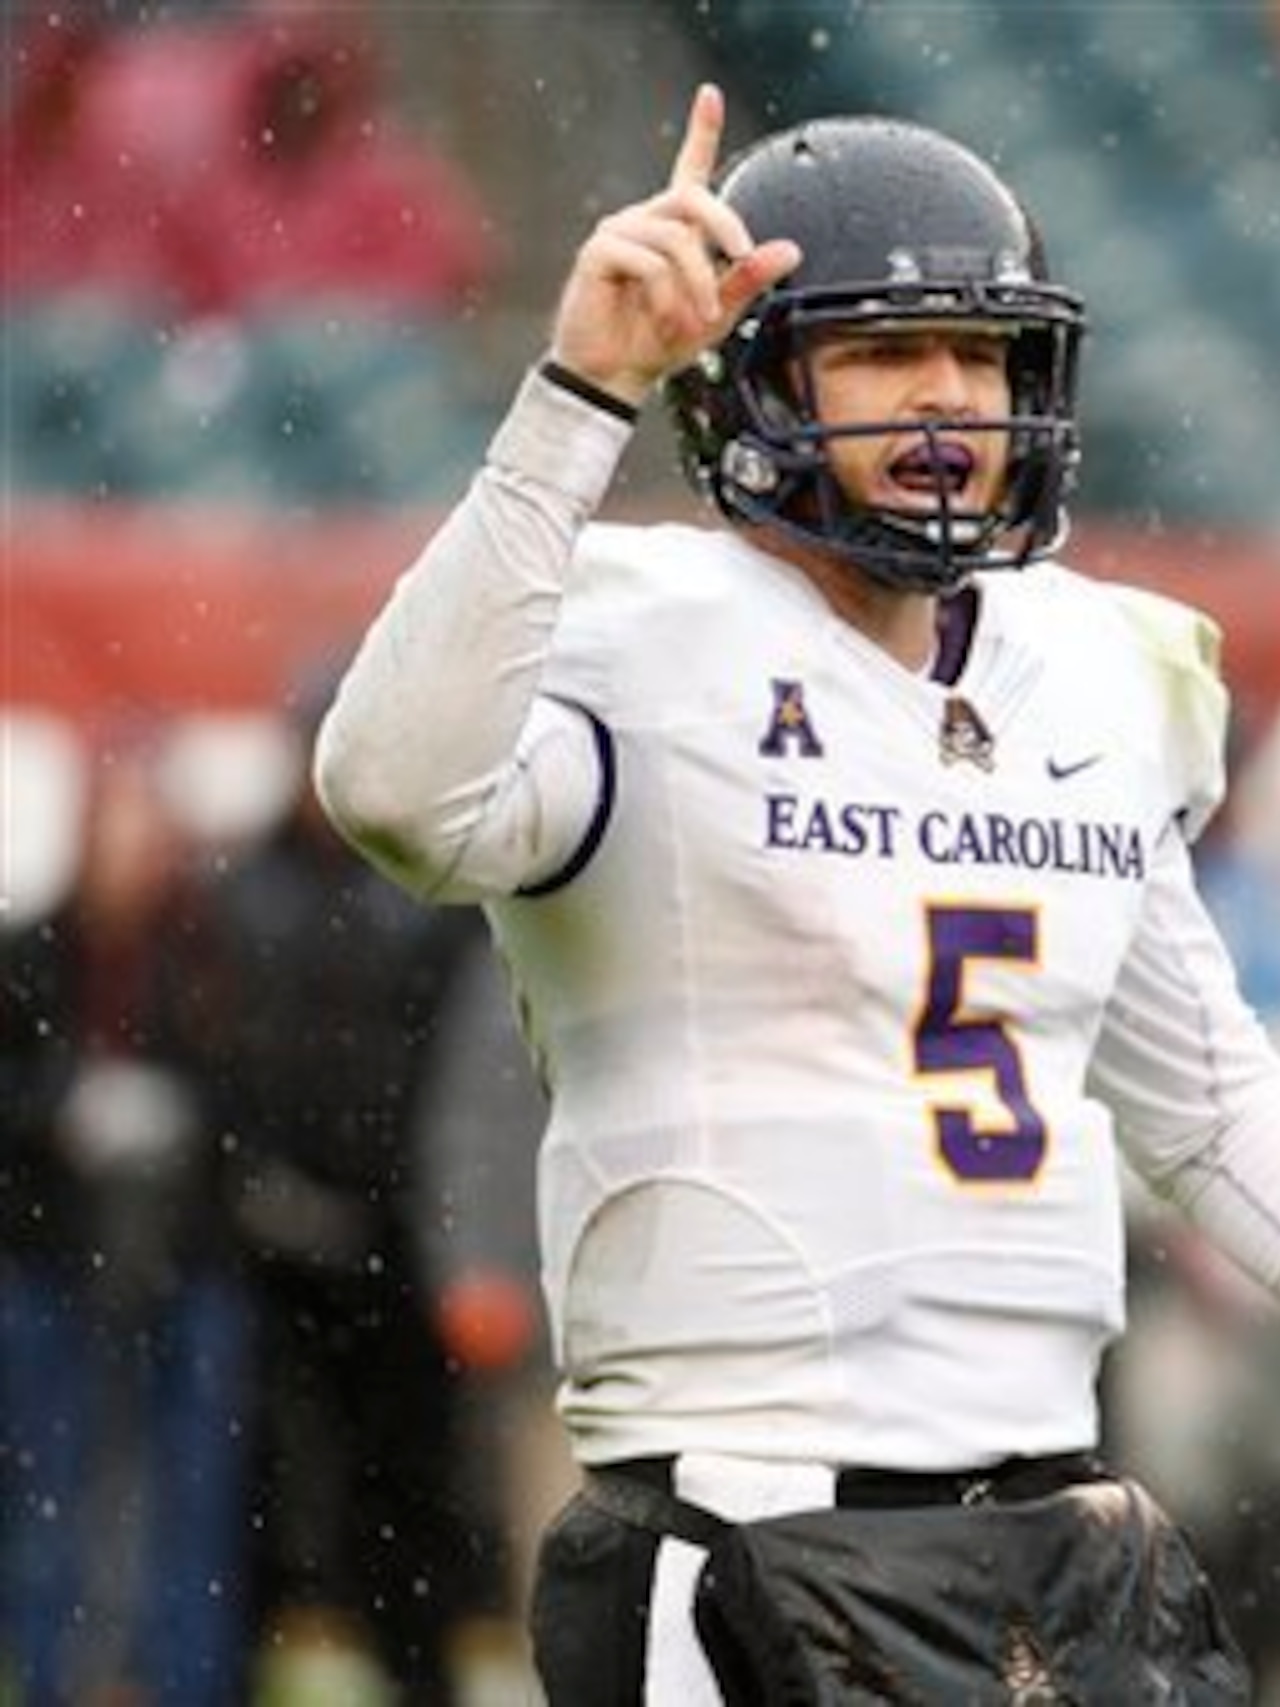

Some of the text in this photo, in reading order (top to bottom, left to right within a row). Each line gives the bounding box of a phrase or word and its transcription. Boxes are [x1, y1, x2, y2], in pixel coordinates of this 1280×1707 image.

[759, 679, 823, 757] A
[765, 794, 1145, 880] EAST CAROLINA
[909, 895, 1049, 1188] 5
